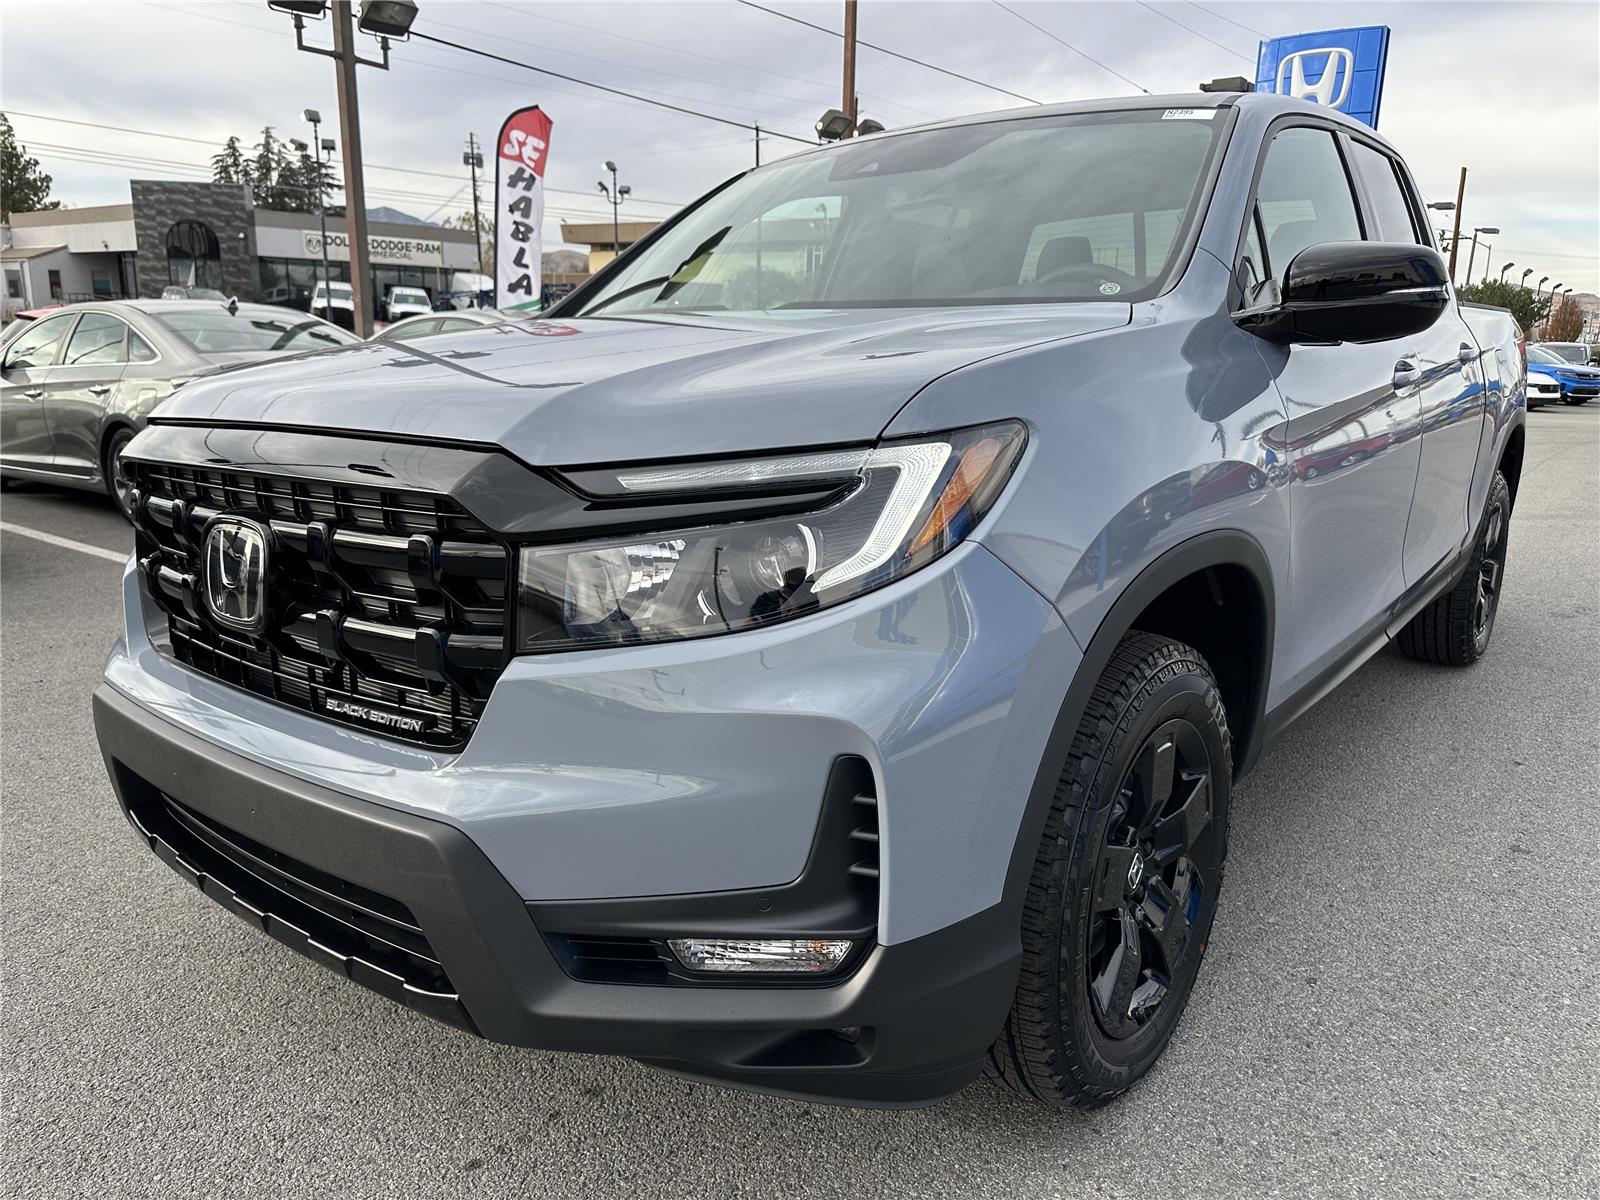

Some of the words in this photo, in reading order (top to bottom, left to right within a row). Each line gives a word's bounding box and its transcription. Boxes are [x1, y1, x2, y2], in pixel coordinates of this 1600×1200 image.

[503, 129, 545, 168] SE
[506, 166, 537, 296] HABLA
[368, 249, 413, 260] MMERCIAL
[325, 697, 369, 719] BLACK
[369, 710, 423, 731] EDITION
